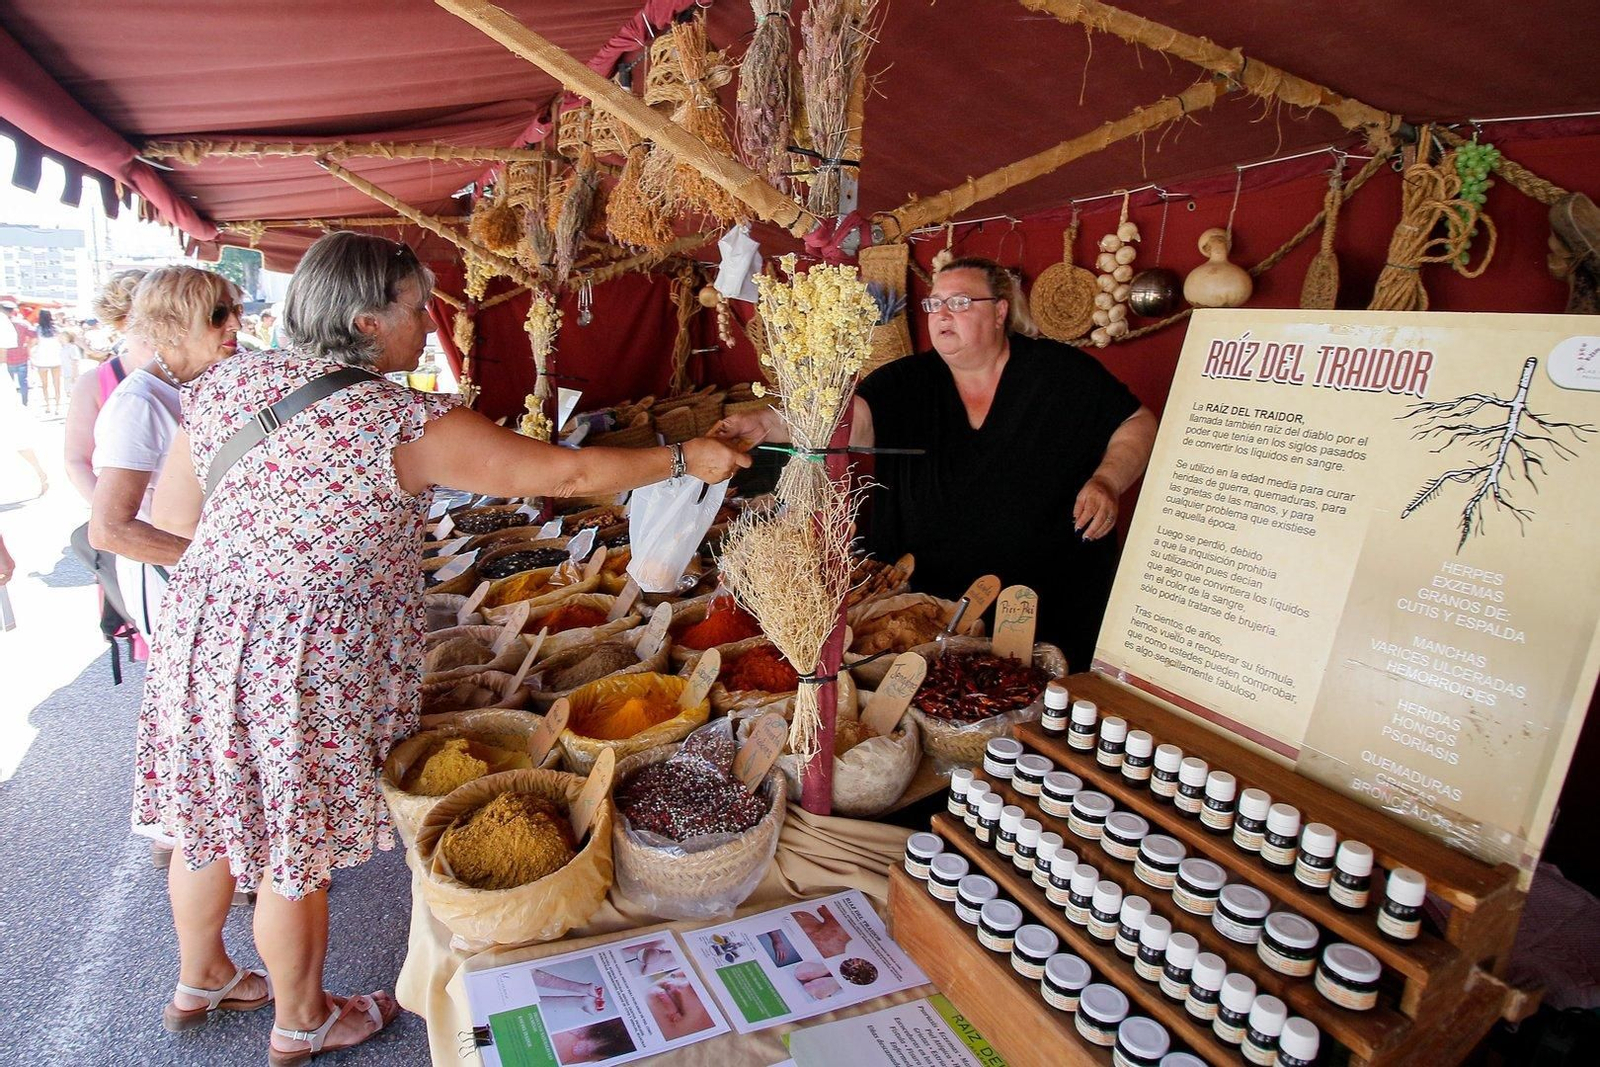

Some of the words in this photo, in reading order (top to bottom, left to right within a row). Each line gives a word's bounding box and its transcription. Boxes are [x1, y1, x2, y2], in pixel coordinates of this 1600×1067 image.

[1203, 332, 1260, 378] RAÍZ
[1260, 343, 1304, 383] DEL
[1315, 344, 1435, 397] TRAIDOR
[1188, 413, 1223, 426] llamada
[1225, 418, 1262, 432] también
[1284, 426, 1301, 437] del
[1302, 429, 1335, 442] diablo
[1336, 435, 1356, 445] por
[1358, 436, 1370, 447] el
[1192, 402, 1203, 411] La
[1205, 403, 1230, 414] RAÍZ
[1230, 406, 1251, 417] DEL
[1254, 409, 1306, 426] TRAIDOR,
[1182, 437, 1194, 446] de
[1195, 440, 1234, 453] convertir
[1235, 445, 1250, 456] los
[1291, 456, 1304, 465] en
[1184, 426, 1211, 436] poder
[1212, 430, 1230, 440] que
[1256, 437, 1269, 446] en
[1271, 437, 1286, 448] los
[1288, 440, 1319, 453] siglos
[1319, 446, 1368, 461] pasados
[1176, 459, 1188, 469] Se
[1190, 463, 1216, 474] utilizó
[1217, 468, 1229, 477] en
[1230, 469, 1240, 479] la
[1241, 472, 1267, 484] edad
[1267, 478, 1299, 491] media
[1300, 484, 1325, 496] para
[1328, 489, 1358, 501] curar
[1206, 477, 1218, 487] de
[1322, 502, 1348, 515] para
[1162, 507, 1174, 516] en
[1175, 510, 1207, 524] aquella
[1208, 516, 1239, 532] época.
[1166, 495, 1206, 510] cualquier
[1206, 504, 1250, 521] problema
[1251, 515, 1270, 525] que
[1272, 520, 1318, 536] existiese
[1169, 482, 1182, 492] las
[1183, 486, 1214, 499] grietas
[1215, 492, 1227, 502] de
[1228, 494, 1243, 506] las
[1282, 508, 1291, 518] y
[1291, 510, 1316, 522] para
[1156, 525, 1184, 540] Luego
[1184, 534, 1196, 543] se
[1230, 545, 1264, 561] debido
[1161, 541, 1178, 551] que
[1178, 543, 1187, 554] la
[1150, 550, 1161, 559] su
[1162, 553, 1205, 572] utilización
[1205, 566, 1229, 579] pues
[1441, 561, 1503, 586] HERPES
[1144, 573, 1155, 582] en
[1156, 576, 1165, 585] el
[1165, 580, 1188, 592] color
[1188, 586, 1200, 596] de
[1202, 589, 1211, 600] la
[1147, 562, 1163, 572] que
[1164, 566, 1183, 578] algo
[1184, 573, 1202, 584] que
[1203, 579, 1252, 600] convirtiera
[1253, 592, 1269, 604] los
[1418, 588, 1480, 613] GRANOS
[1432, 576, 1504, 602] EXZEMAS
[1140, 584, 1158, 595] sólo
[1188, 599, 1222, 617] tratarse
[1224, 611, 1237, 622] de
[1397, 598, 1439, 619] CUTIS
[1442, 611, 1454, 622] Y
[1455, 615, 1525, 643] ESPALDA
[1130, 616, 1158, 634] hemos
[1160, 629, 1186, 644] vuelto
[1187, 640, 1194, 648] a
[1195, 642, 1241, 665] recuperar
[1242, 660, 1255, 671] su
[1135, 605, 1152, 619] Tras
[1154, 614, 1185, 631] cientos
[1186, 625, 1198, 636] de
[1199, 631, 1224, 647] años,
[1124, 641, 1134, 650] es
[1135, 646, 1154, 658] algo
[1127, 630, 1143, 641] que
[1144, 636, 1168, 651] como
[1169, 646, 1204, 665] ustedes
[1204, 660, 1241, 680] pueden
[1413, 636, 1486, 668] MANCHAS
[1371, 638, 1429, 666] VARICES
[1433, 656, 1526, 699] ULCERADAS
[1386, 660, 1497, 706] HEMORROIDES
[1392, 713, 1457, 746] HONGOS
[1398, 699, 1461, 730] HERIDAS
[1381, 726, 1459, 766] PSORIASIS
[1361, 750, 1462, 802] QUEMADURAS
[952, 1014, 982, 1042] RAIZ
